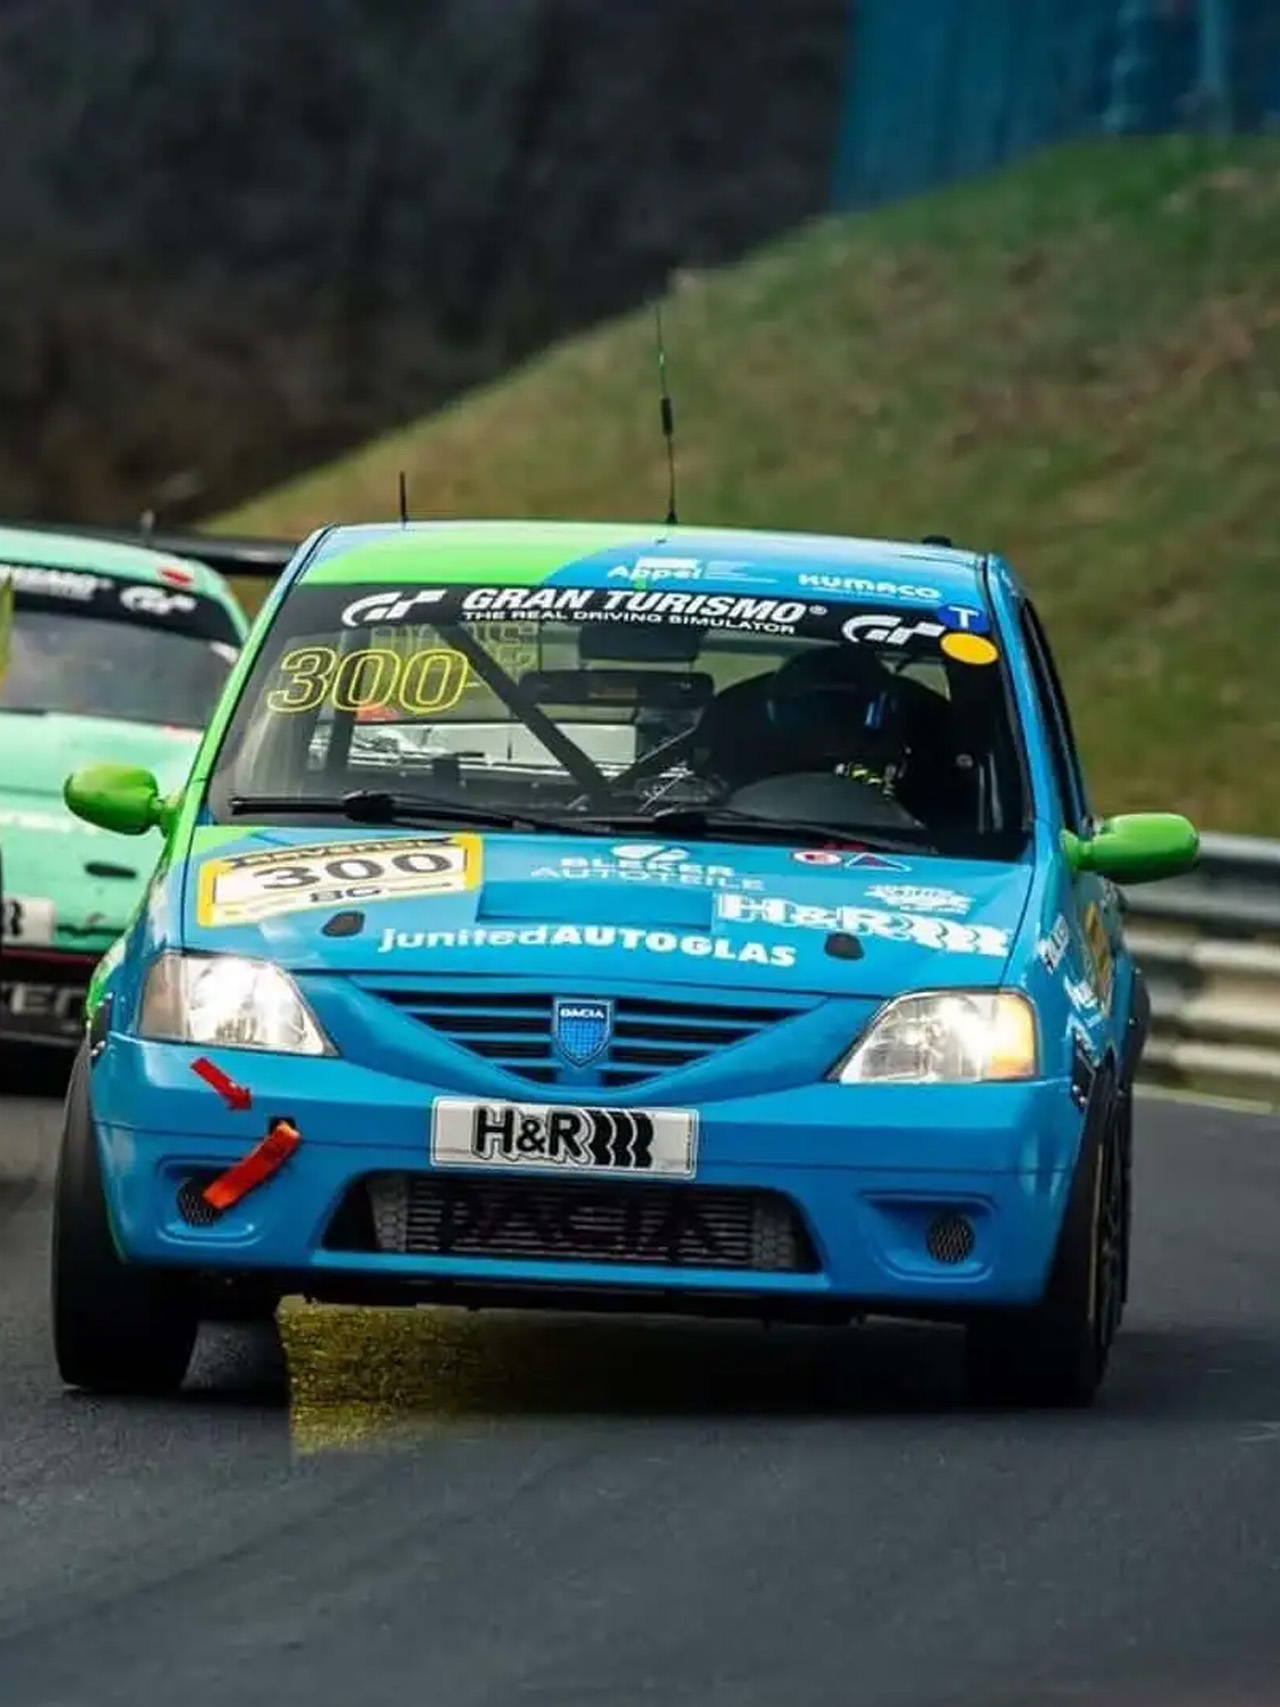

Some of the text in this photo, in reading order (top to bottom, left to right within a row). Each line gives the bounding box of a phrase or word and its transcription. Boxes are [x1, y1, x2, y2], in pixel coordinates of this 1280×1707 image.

[462, 588, 594, 610] GRAN
[464, 610, 796, 635] THE REAL DRIVING SIMULATOR
[949, 605, 980, 630] T
[266, 647, 469, 713] 300
[253, 852, 453, 890] 300
[530, 866, 766, 892] AUTOTEILE
[561, 856, 735, 877] BLEKER
[560, 1007, 605, 1019] DACIA
